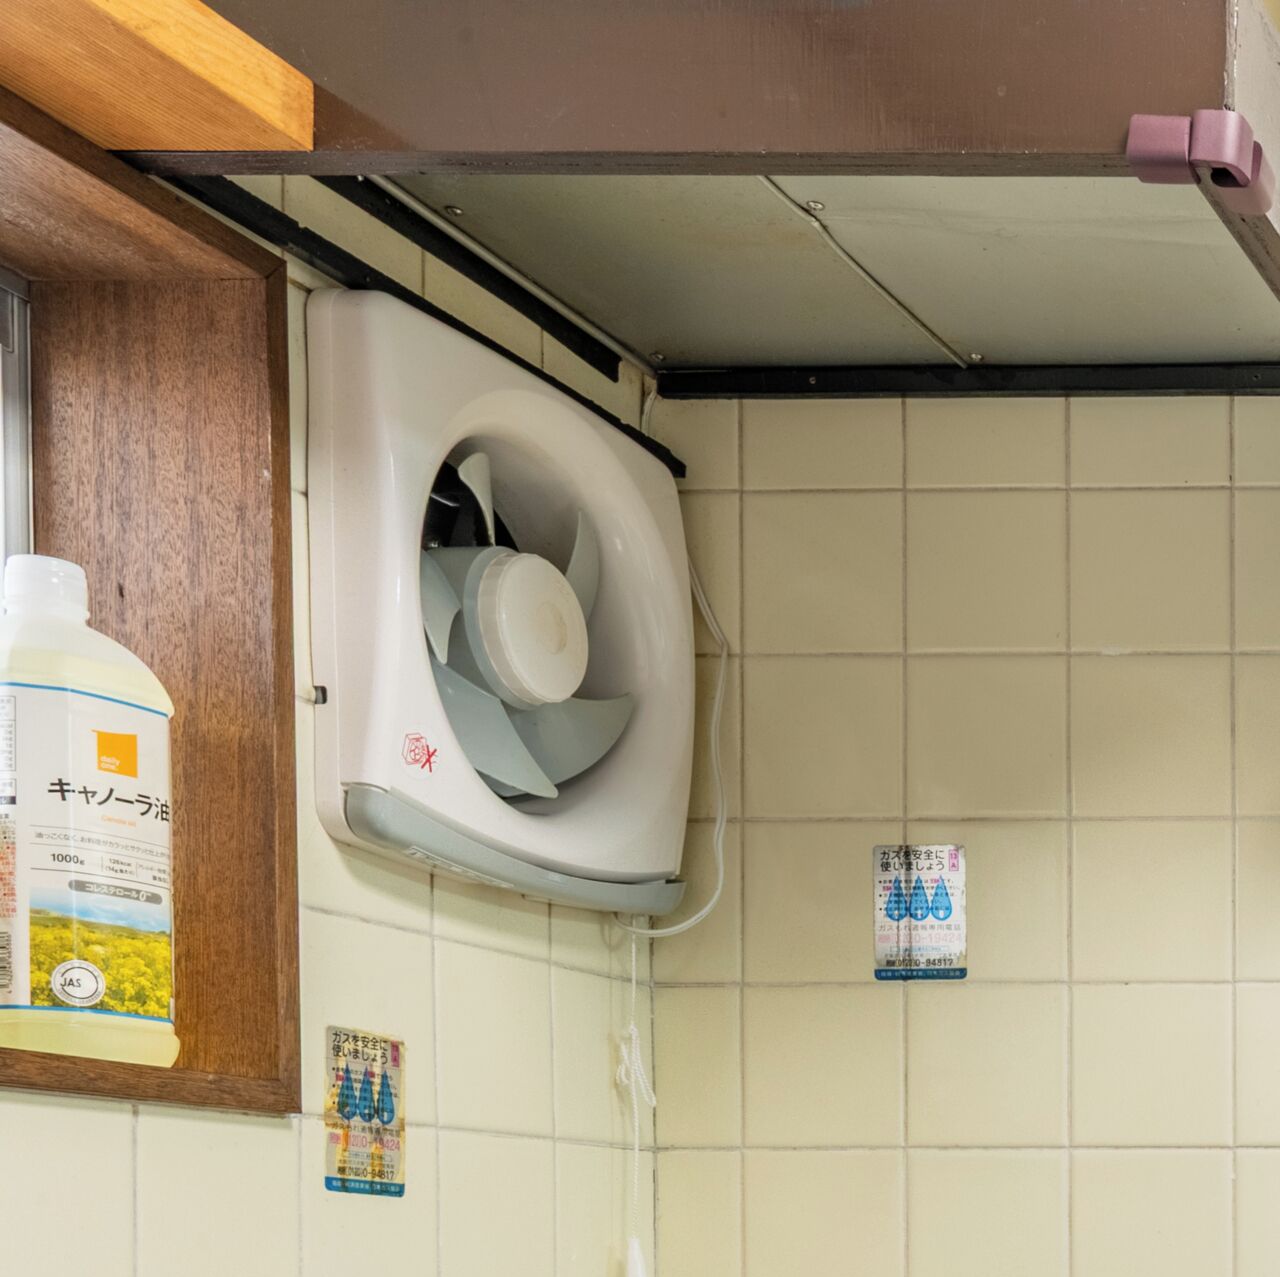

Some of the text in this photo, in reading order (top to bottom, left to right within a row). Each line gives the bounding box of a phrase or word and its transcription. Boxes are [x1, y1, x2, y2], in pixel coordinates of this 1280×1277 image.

[48, 778, 170, 823] キャノーラ油
[50, 853, 86, 867] 1000g
[880, 849, 945, 861] ガスを安全に
[880, 860, 945, 872] 使いましょう
[60, 978, 82, 989] JAS
[332, 1030, 388, 1052] ガスを安全に
[332, 1044, 388, 1065] 使いましょう
